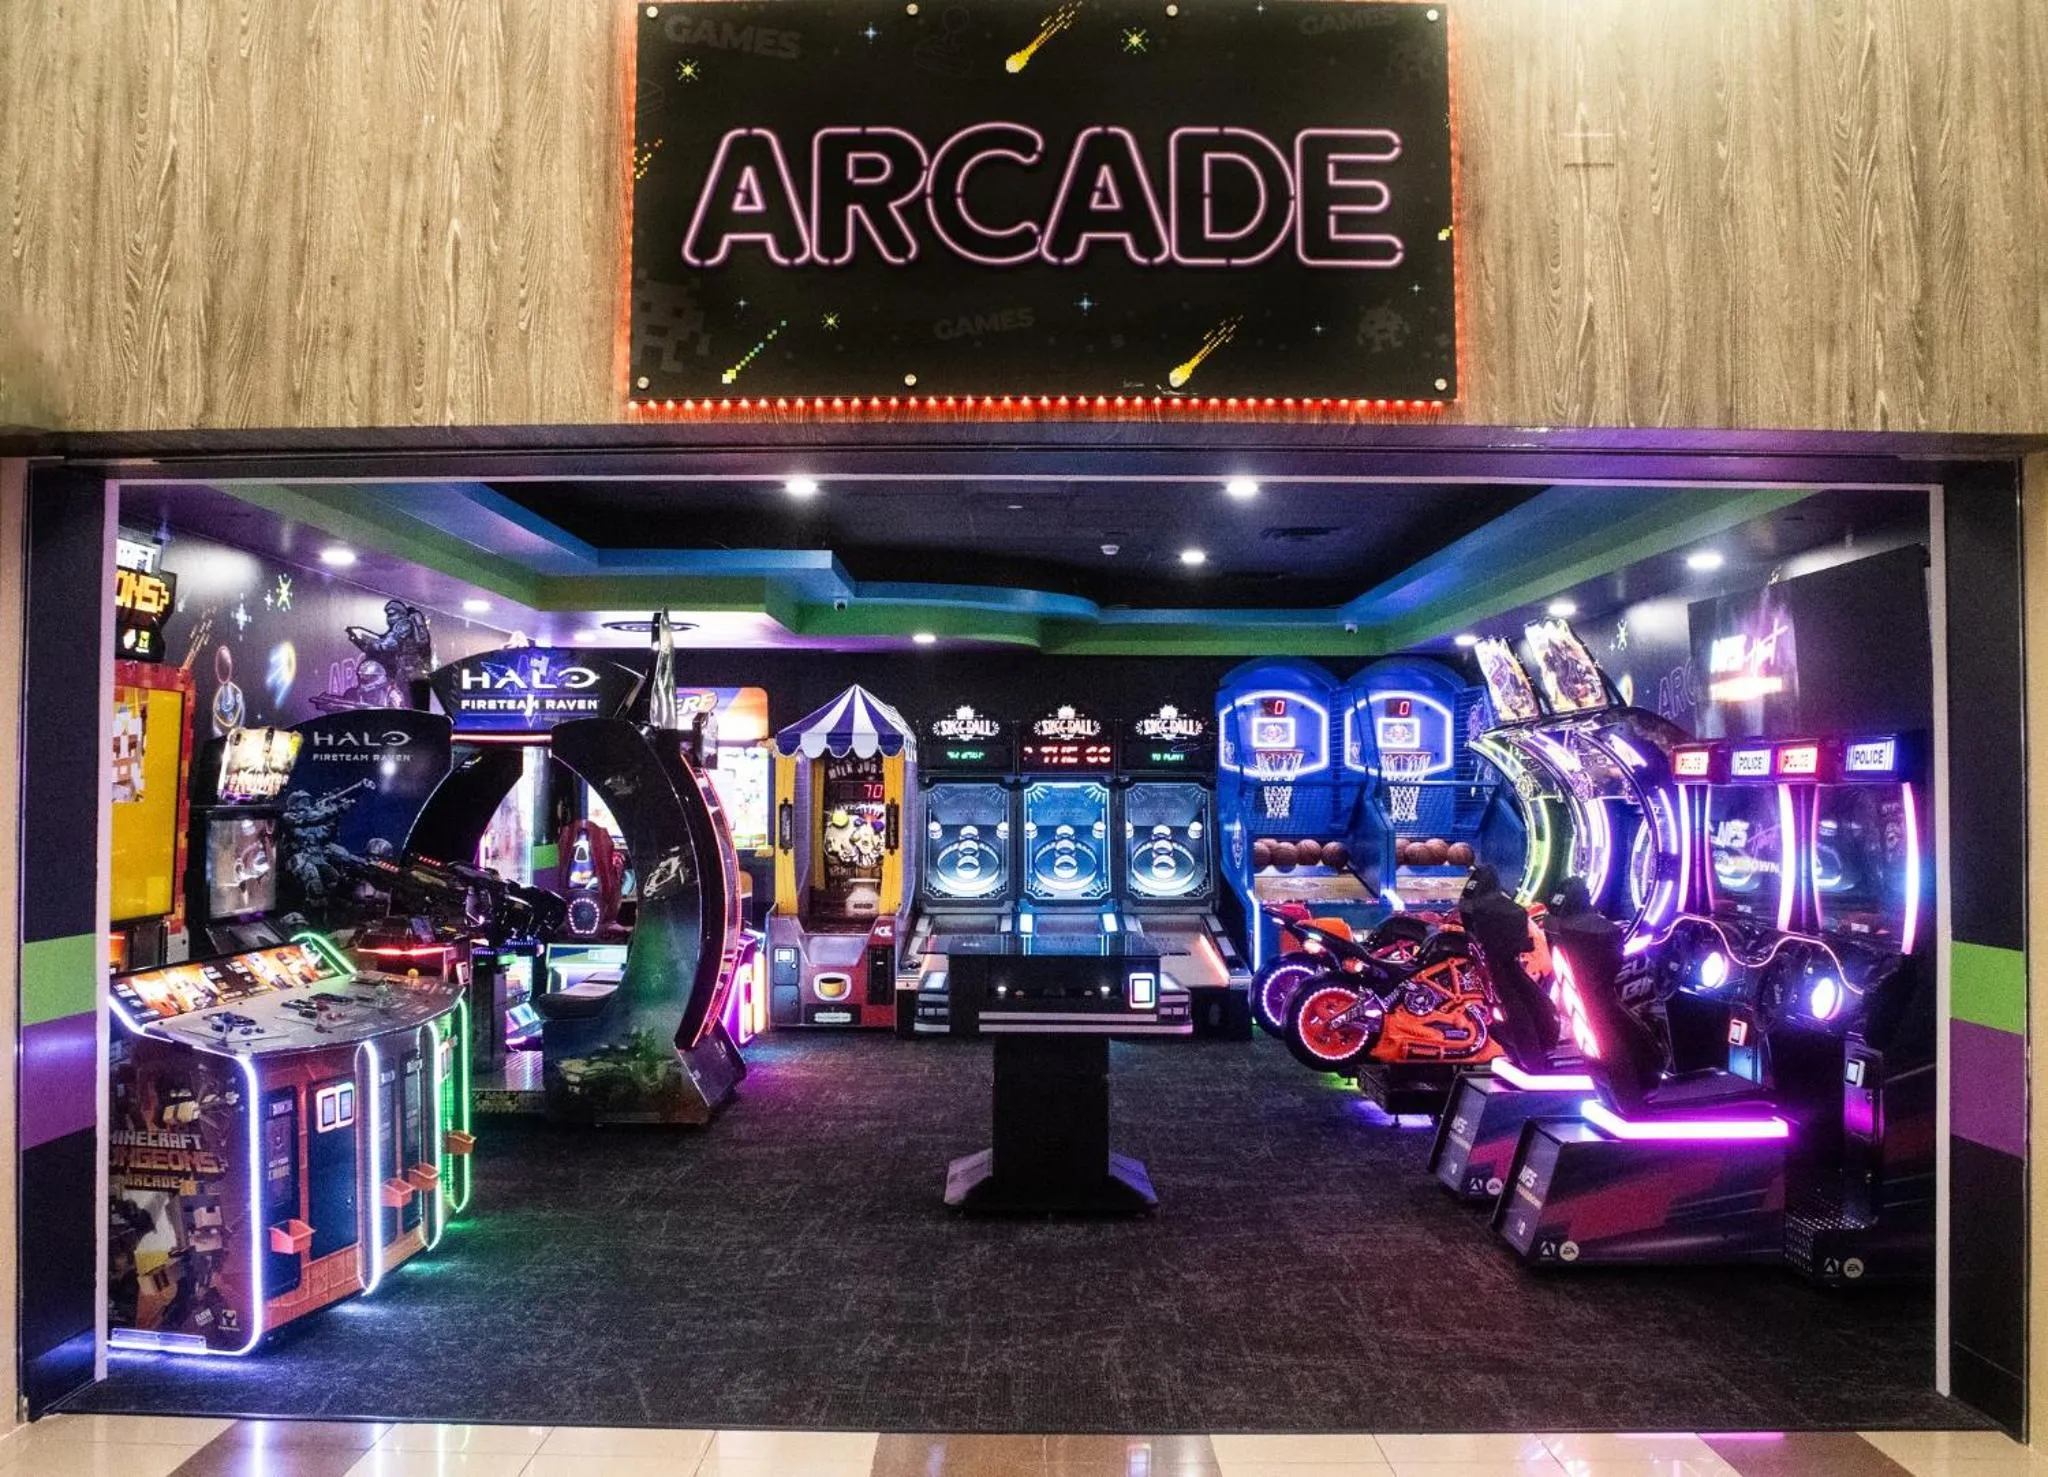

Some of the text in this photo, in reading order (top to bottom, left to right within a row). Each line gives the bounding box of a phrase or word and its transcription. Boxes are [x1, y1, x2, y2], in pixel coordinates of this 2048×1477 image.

[664, 13, 802, 60] GAMES
[682, 122, 1404, 266] ARCADE
[933, 306, 1036, 340] GAMES
[462, 667, 600, 689] HALO
[461, 700, 598, 710] FIRETEAM RAVEN
[313, 731, 411, 746] HALO
[312, 753, 411, 762] FIRETEAM RAVEN
[1739, 756, 1763, 770] POLICE
[1854, 749, 1884, 765] POLICE
[864, 784, 883, 798] 70
